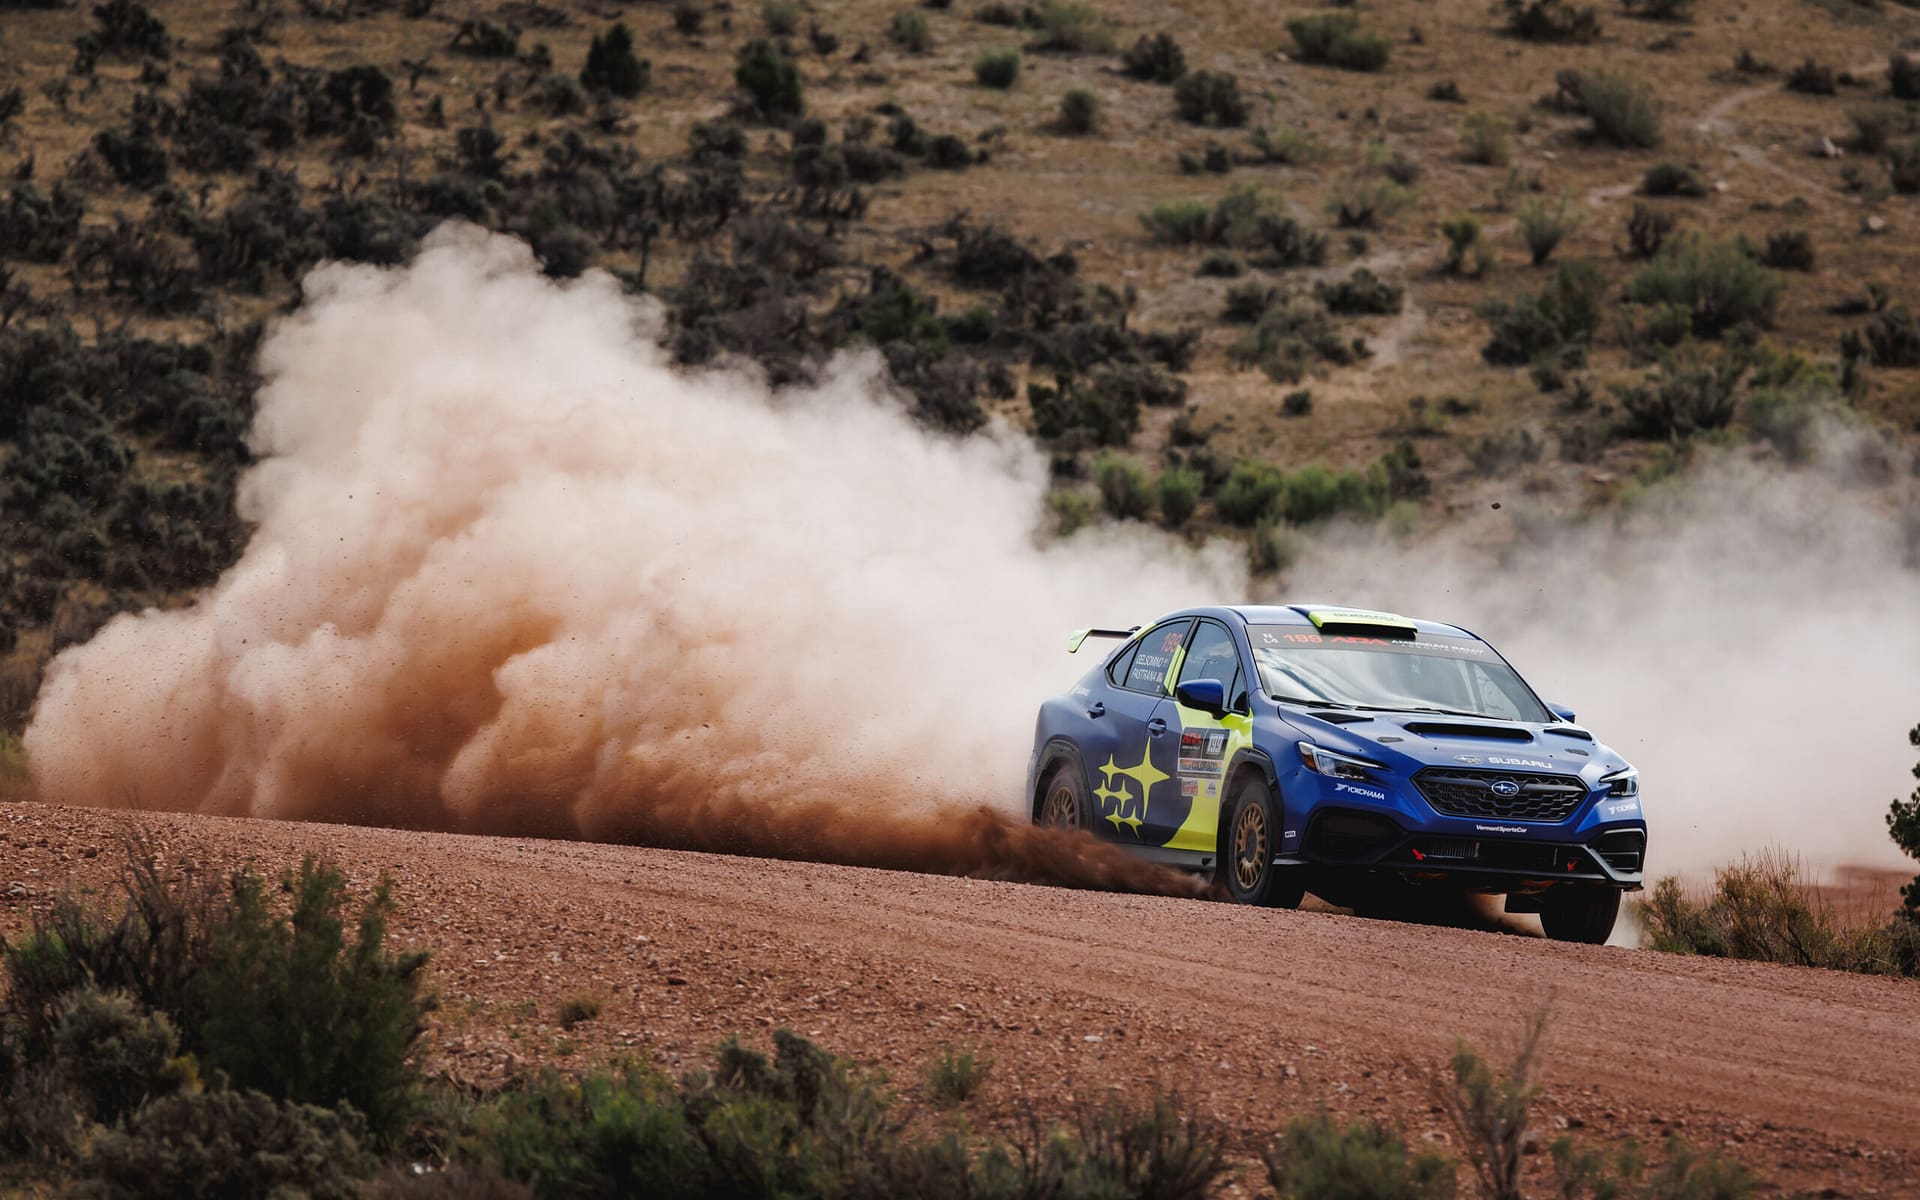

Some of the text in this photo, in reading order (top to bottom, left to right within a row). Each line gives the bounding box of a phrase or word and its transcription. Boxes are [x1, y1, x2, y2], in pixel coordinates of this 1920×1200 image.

[1283, 634, 1324, 643] 199
[1488, 756, 1553, 769] SUBARU
[1346, 785, 1385, 800] YOKOHAMA
